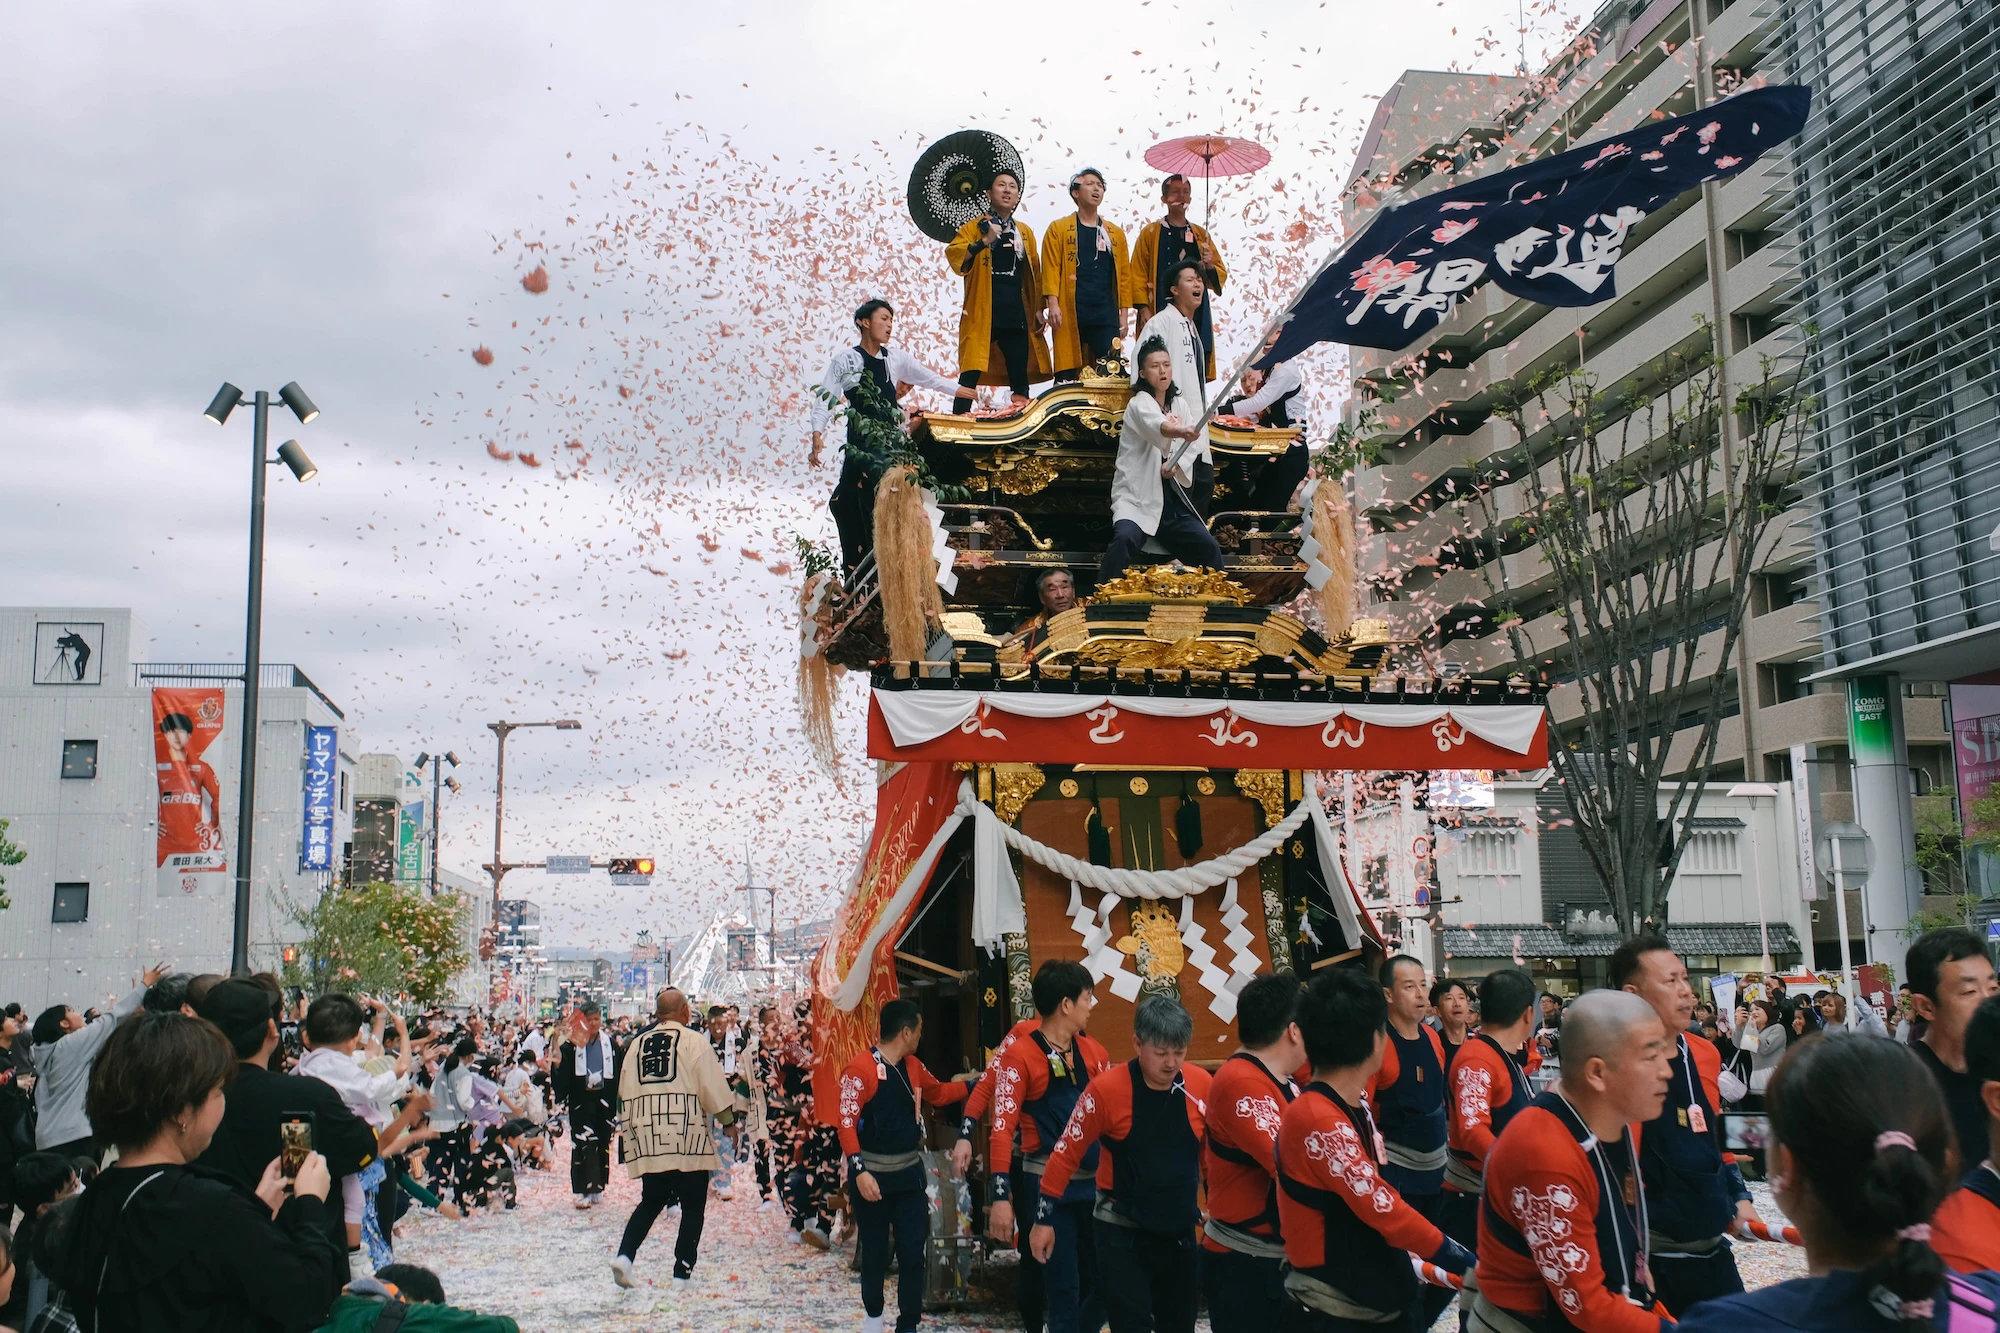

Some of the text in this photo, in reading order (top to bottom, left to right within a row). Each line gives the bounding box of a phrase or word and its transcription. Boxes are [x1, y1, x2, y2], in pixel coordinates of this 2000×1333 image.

[1066, 224, 1076, 263] 上山方
[1179, 322, 1194, 364] 下山方
[1854, 697, 1885, 706] COMO
[1859, 713, 1881, 721] EAST
[307, 732, 331, 865] ヤマウチ写真場
[200, 827, 224, 851] 32
[1799, 808, 1812, 888] しばそう
